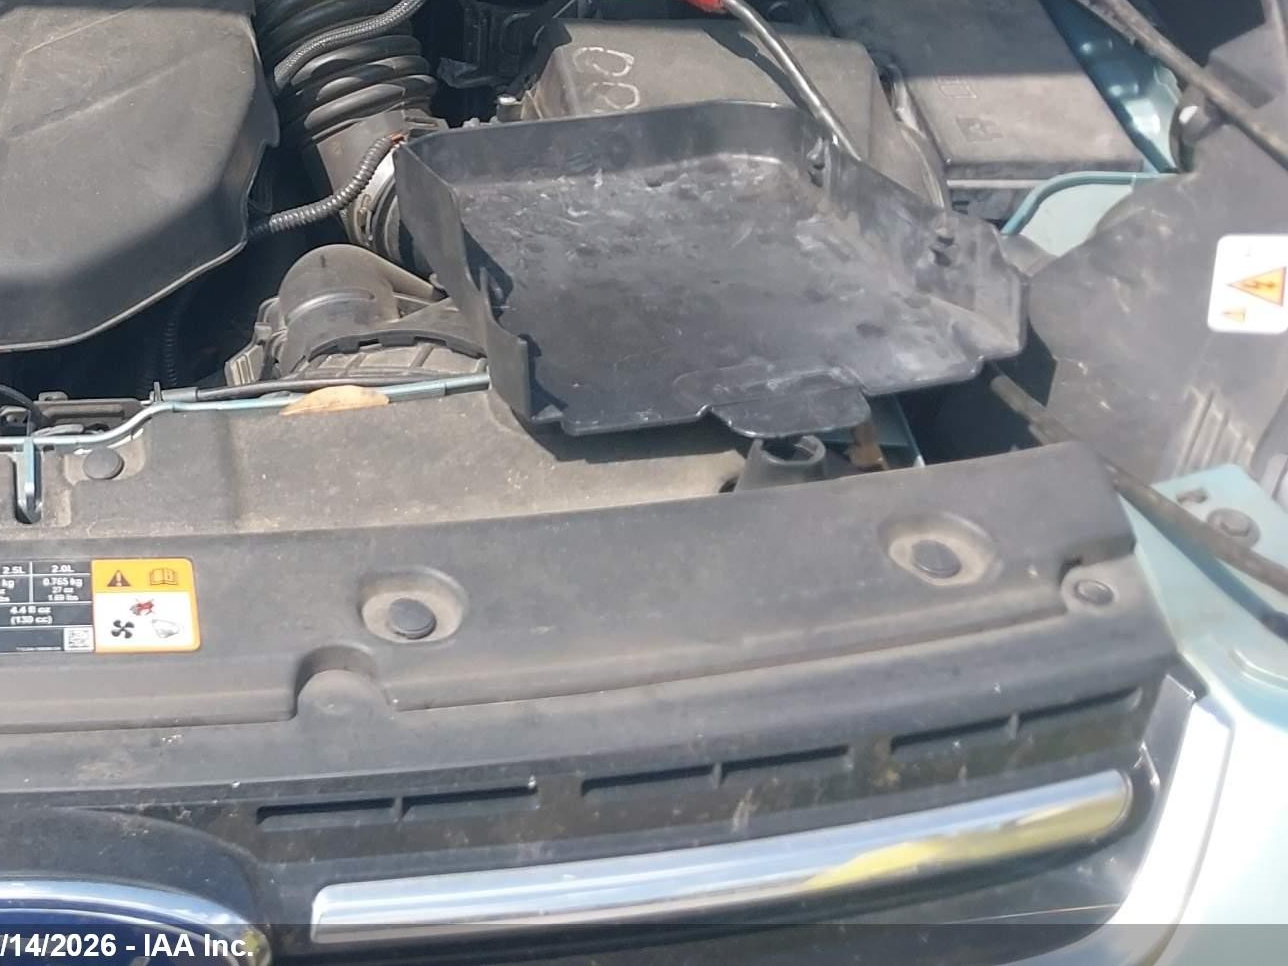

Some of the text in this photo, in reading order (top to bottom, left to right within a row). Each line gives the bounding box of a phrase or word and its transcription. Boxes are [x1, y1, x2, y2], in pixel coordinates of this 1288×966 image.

[2, 565, 26, 574] 2.5L
[51, 564, 75, 573] 2.0L
[1, 579, 15, 589] kg
[69, 577, 83, 588] kg
